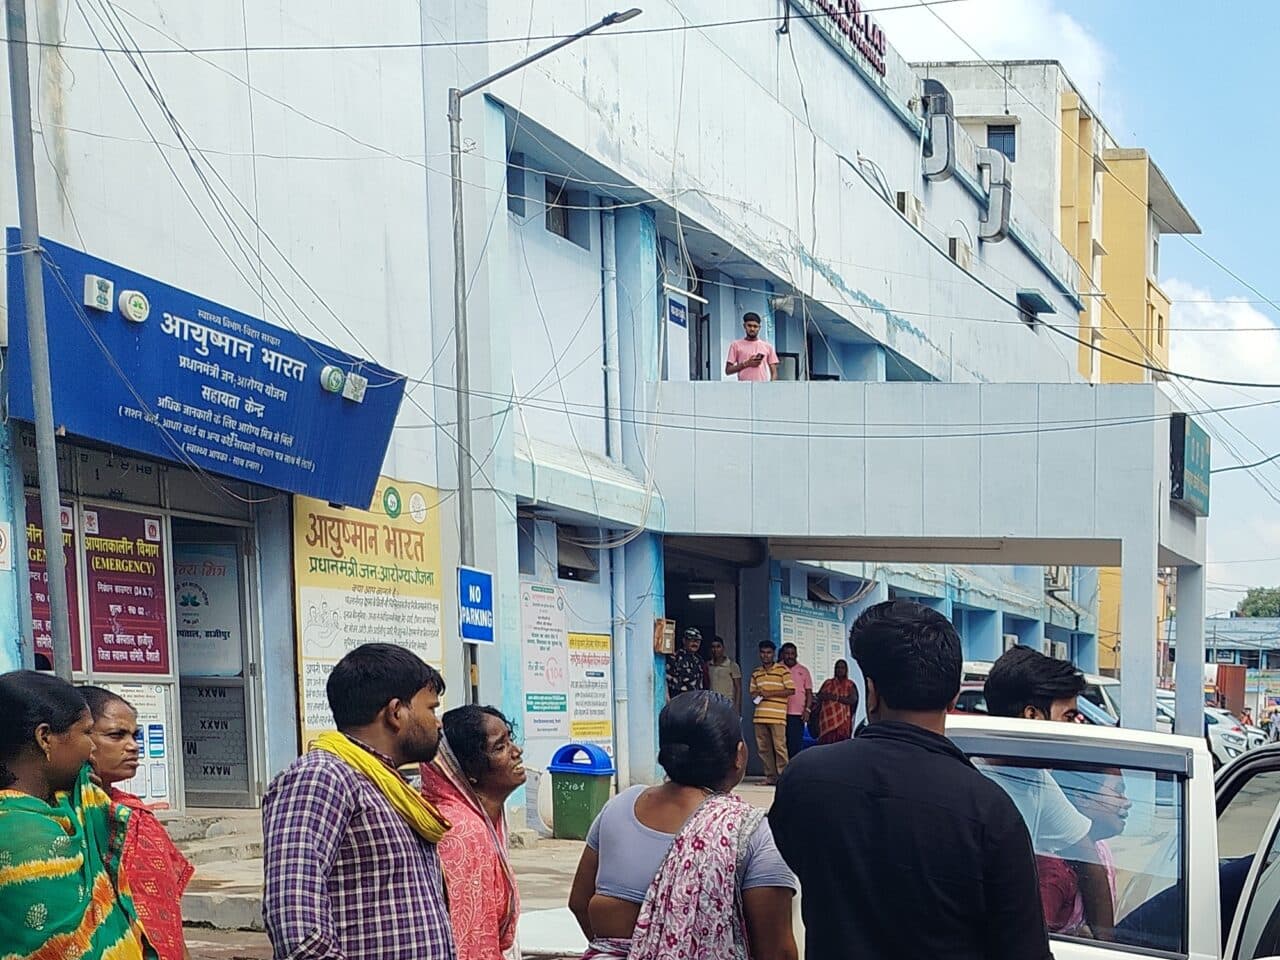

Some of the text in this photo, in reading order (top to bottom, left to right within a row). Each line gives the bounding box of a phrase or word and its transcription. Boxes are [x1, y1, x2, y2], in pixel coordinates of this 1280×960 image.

[160, 312, 307, 382] आयुष्मान भारत
[178, 354, 220, 379] प्रधानमंत्री
[264, 383, 288, 402] योजना
[202, 385, 265, 418] सहायता केन्द्र
[157, 396, 182, 412] अधिक
[182, 404, 213, 423] जानकारी
[222, 414, 237, 430] लिए
[238, 421, 260, 438] आरोग्य
[163, 418, 182, 432] आधार
[84, 536, 134, 556] आपातकालीन
[137, 538, 160, 559] विभाग
[306, 512, 425, 562] आयुष्मान भारत
[92, 554, 156, 576] (EMERGENCY)
[309, 555, 358, 578] प्रधानमंत्री
[469, 584, 481, 603] NO
[462, 606, 493, 629] PARKING
